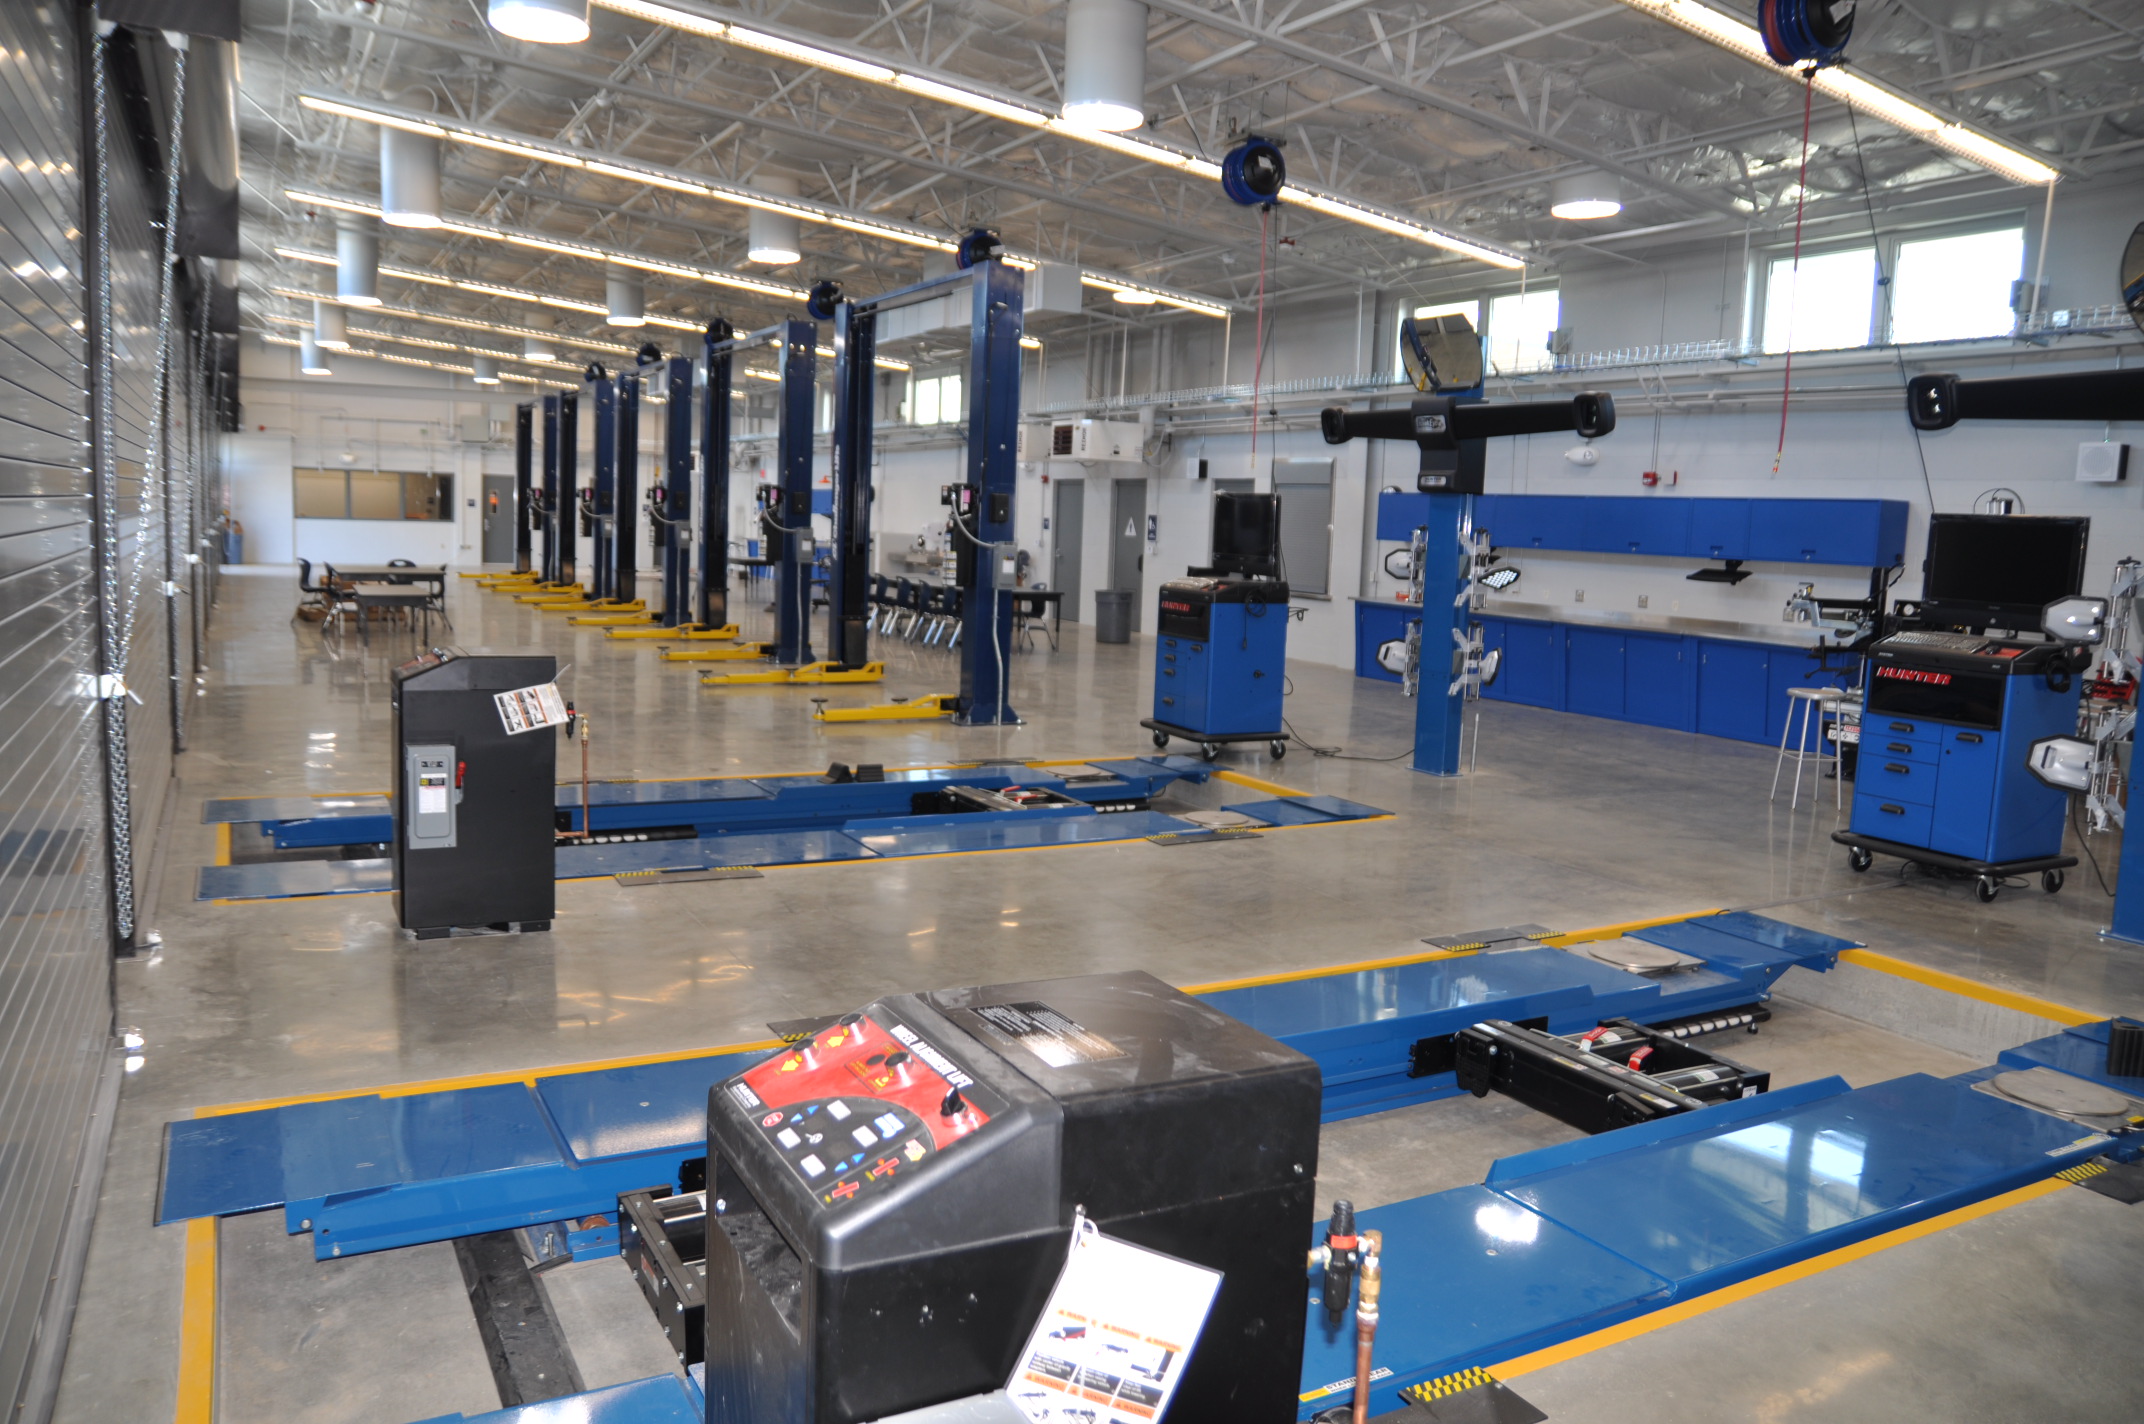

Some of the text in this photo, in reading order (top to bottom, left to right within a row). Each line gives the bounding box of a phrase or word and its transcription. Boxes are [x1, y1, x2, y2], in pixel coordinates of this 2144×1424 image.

[1876, 666, 1952, 685] HUNTER
[890, 1024, 919, 1047] WHEEL
[910, 1041, 958, 1076] ALIGNMENT
[946, 1070, 974, 1089] LIFT
